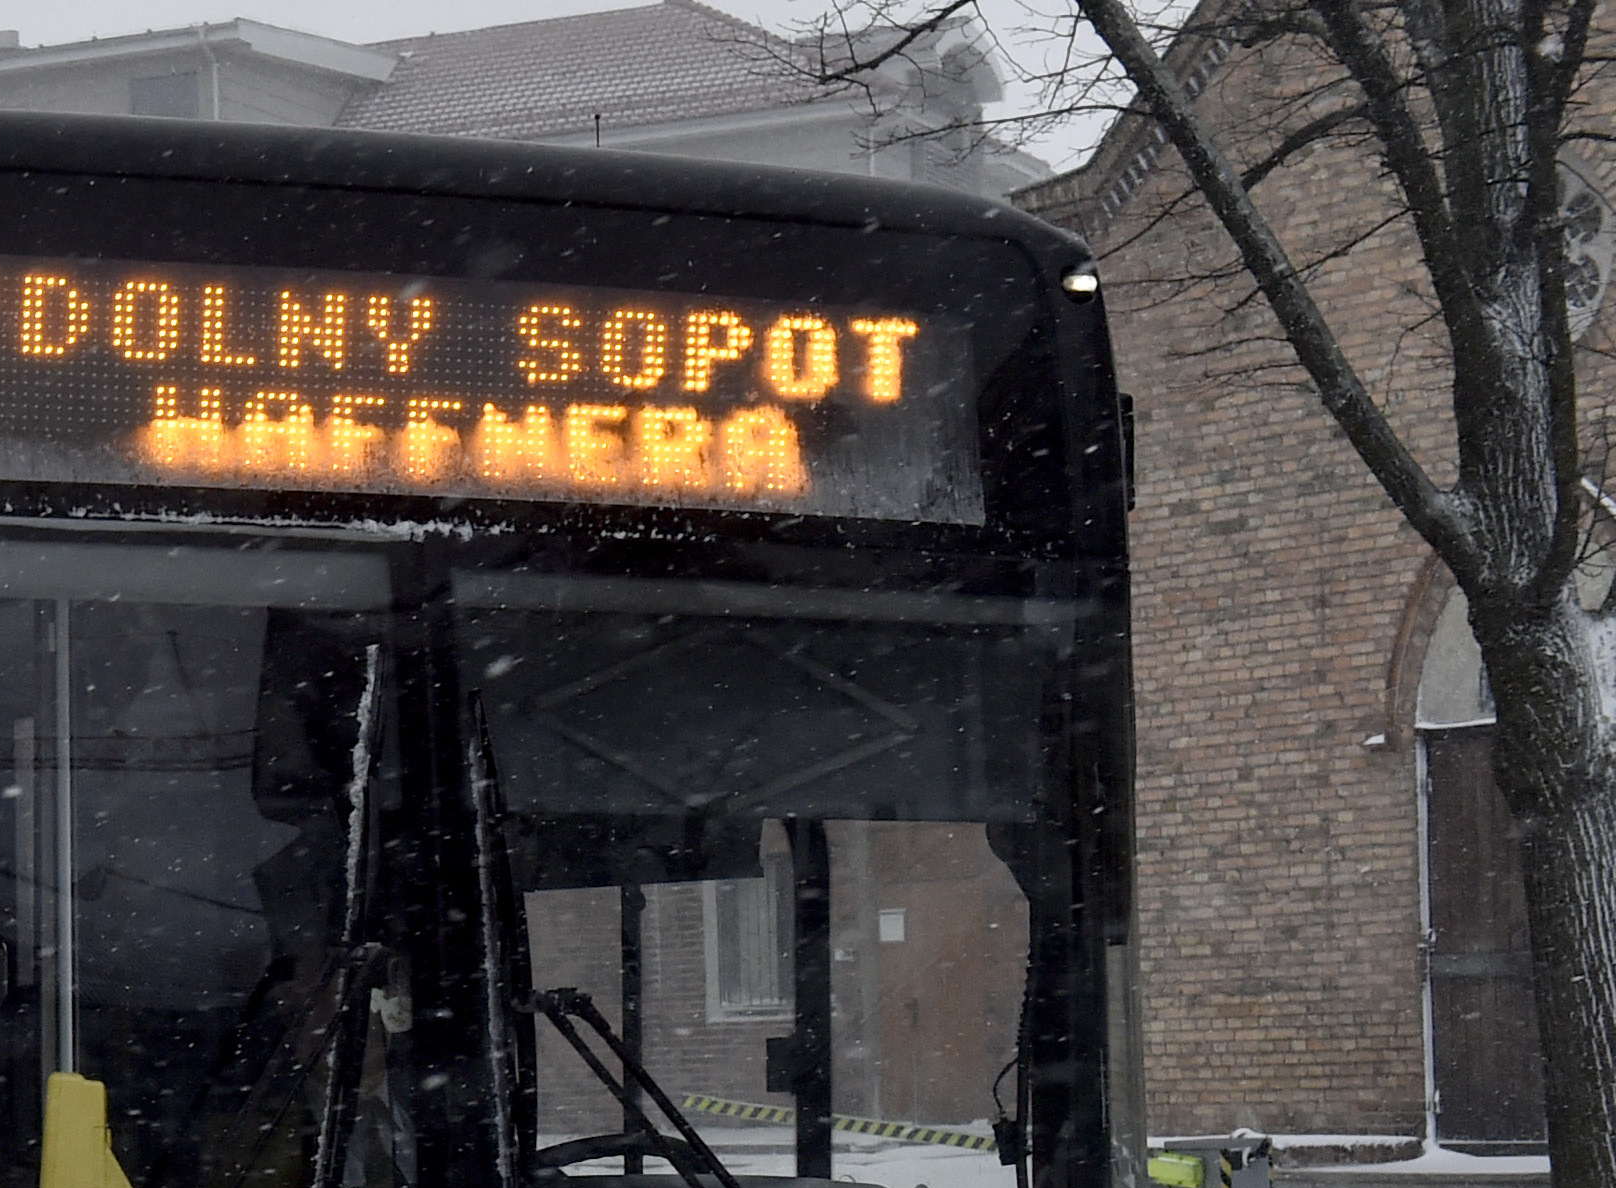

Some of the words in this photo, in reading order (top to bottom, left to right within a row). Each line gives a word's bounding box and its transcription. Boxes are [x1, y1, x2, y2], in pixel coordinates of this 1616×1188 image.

[20, 273, 434, 376] DOLNY
[517, 303, 921, 402] SOPOT
[152, 384, 800, 490] HAFFNERA
